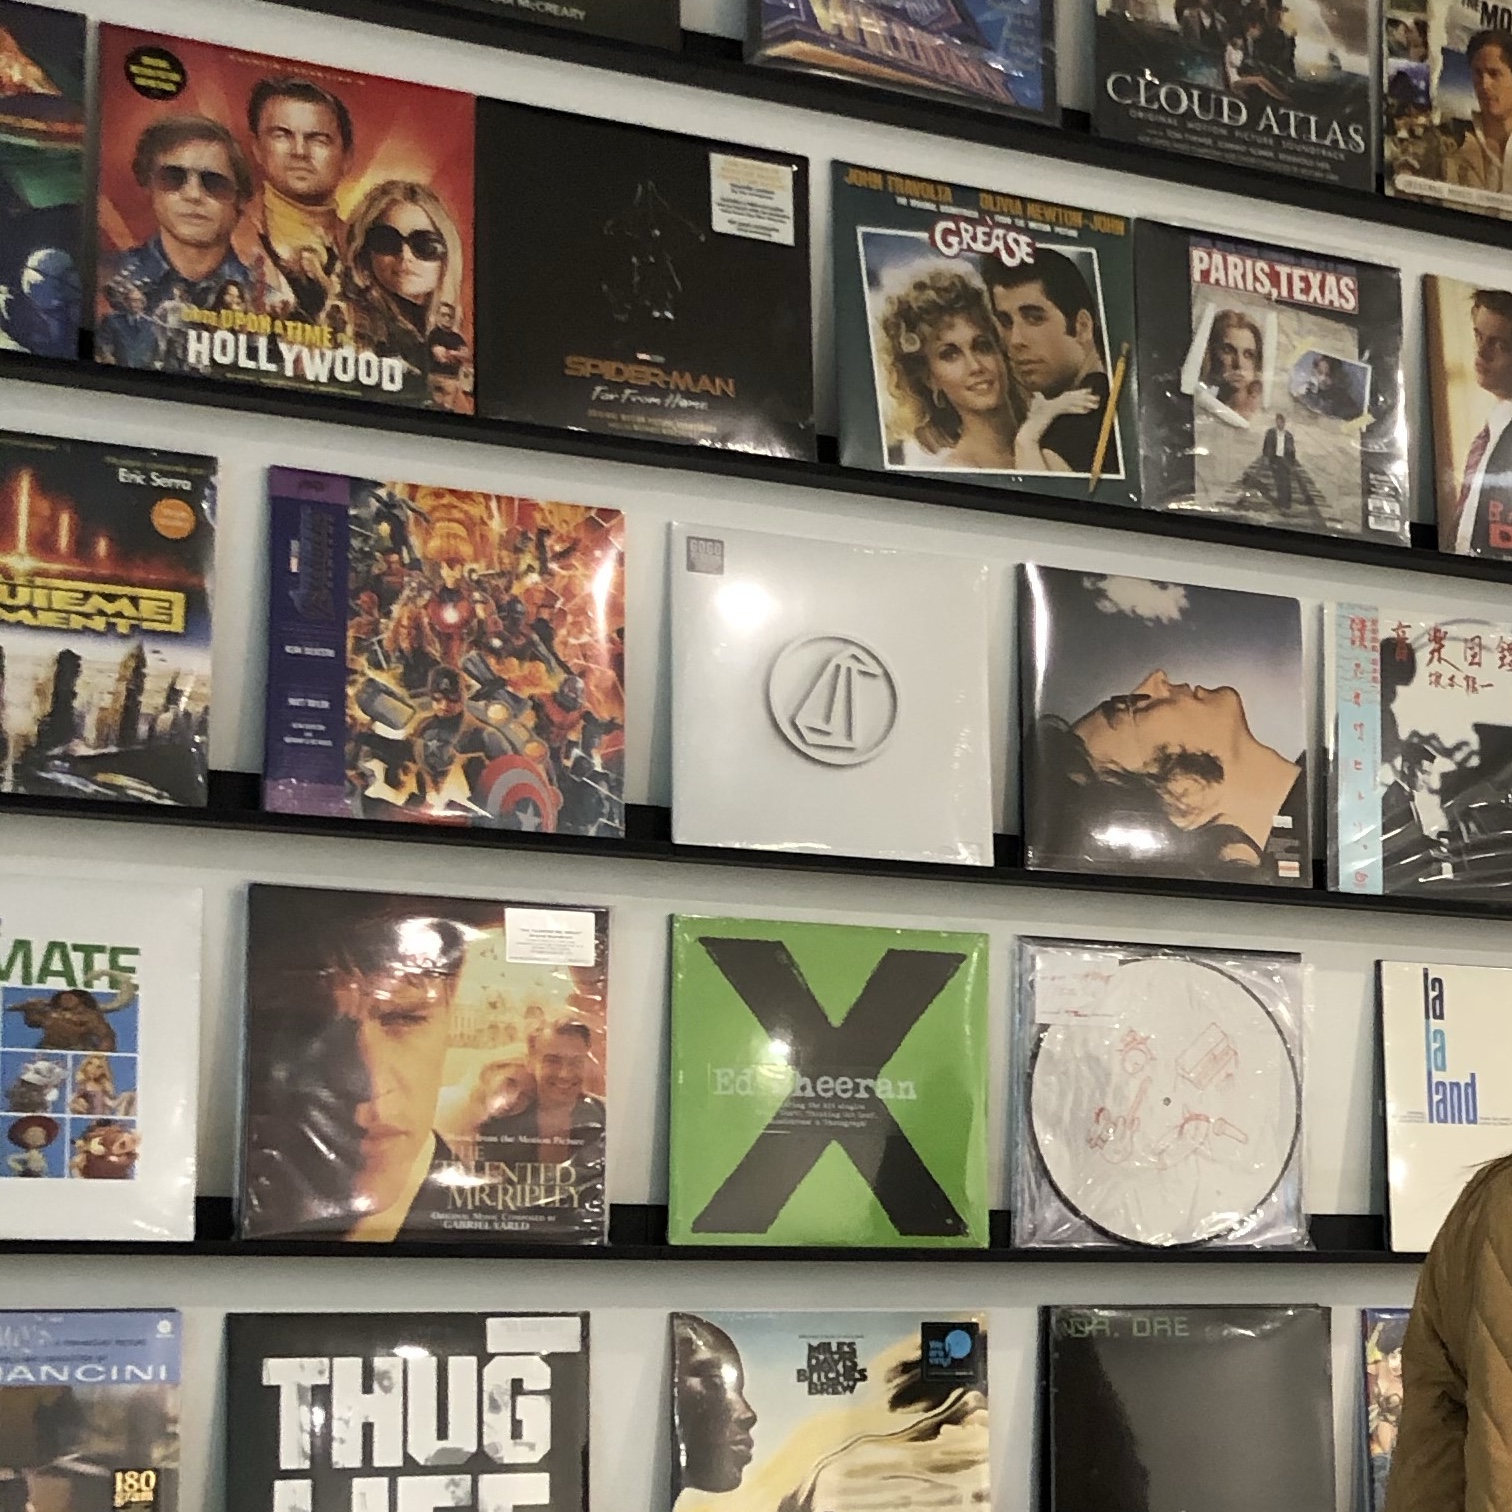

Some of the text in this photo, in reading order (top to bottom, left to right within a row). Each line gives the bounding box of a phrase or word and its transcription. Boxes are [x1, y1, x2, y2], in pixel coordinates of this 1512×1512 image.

[1106, 71, 1366, 154] CLOUD ATLAS
[934, 219, 1036, 268] GREASE
[1274, 264, 1356, 311] TEXAS
[187, 327, 405, 393] HOLLYWOOD
[563, 355, 736, 398] SPIDER-MAN
[118, 468, 192, 490] Eric Serra
[1422, 967, 1445, 1021] la
[758, 1066, 917, 1101] heeran
[1427, 1072, 1478, 1126] land
[1132, 1317, 1189, 1337] DRE
[0, 1363, 168, 1383] ANCINI
[262, 1354, 551, 1471] THUG
[115, 1470, 156, 1493] 180
